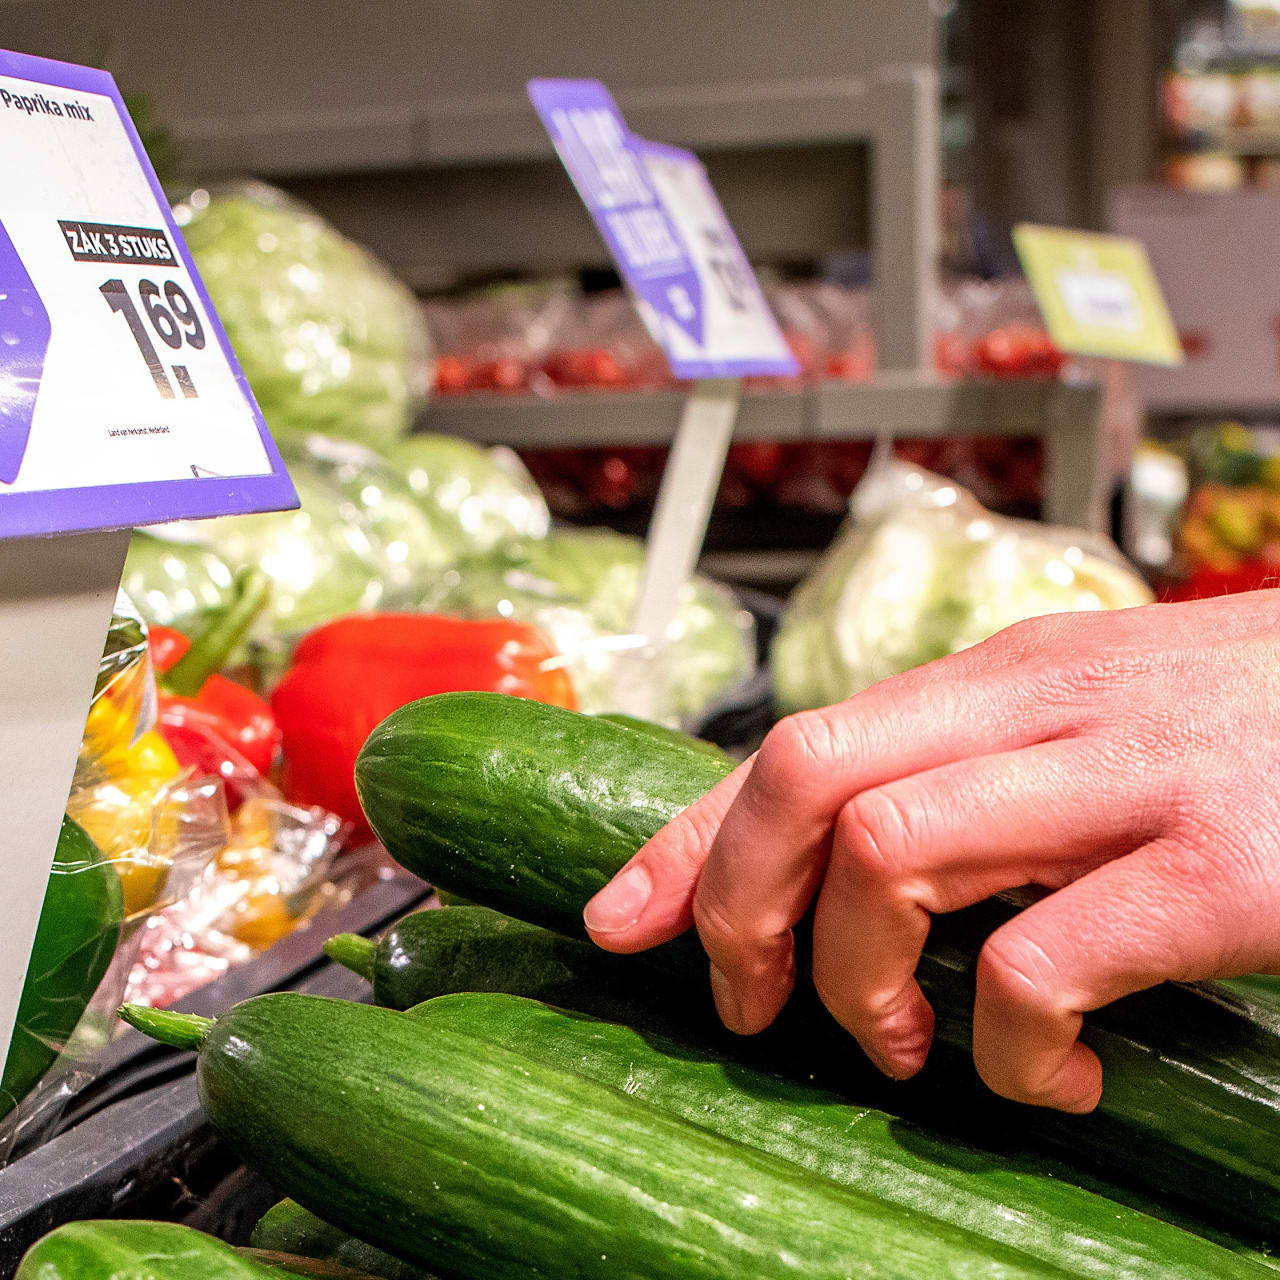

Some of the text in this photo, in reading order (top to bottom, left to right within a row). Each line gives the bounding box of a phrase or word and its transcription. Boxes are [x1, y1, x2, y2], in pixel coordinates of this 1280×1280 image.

[1, 88, 64, 118] Paprika
[63, 101, 95, 122] mix
[66, 229, 172, 261] ZAK 3 STUKS
